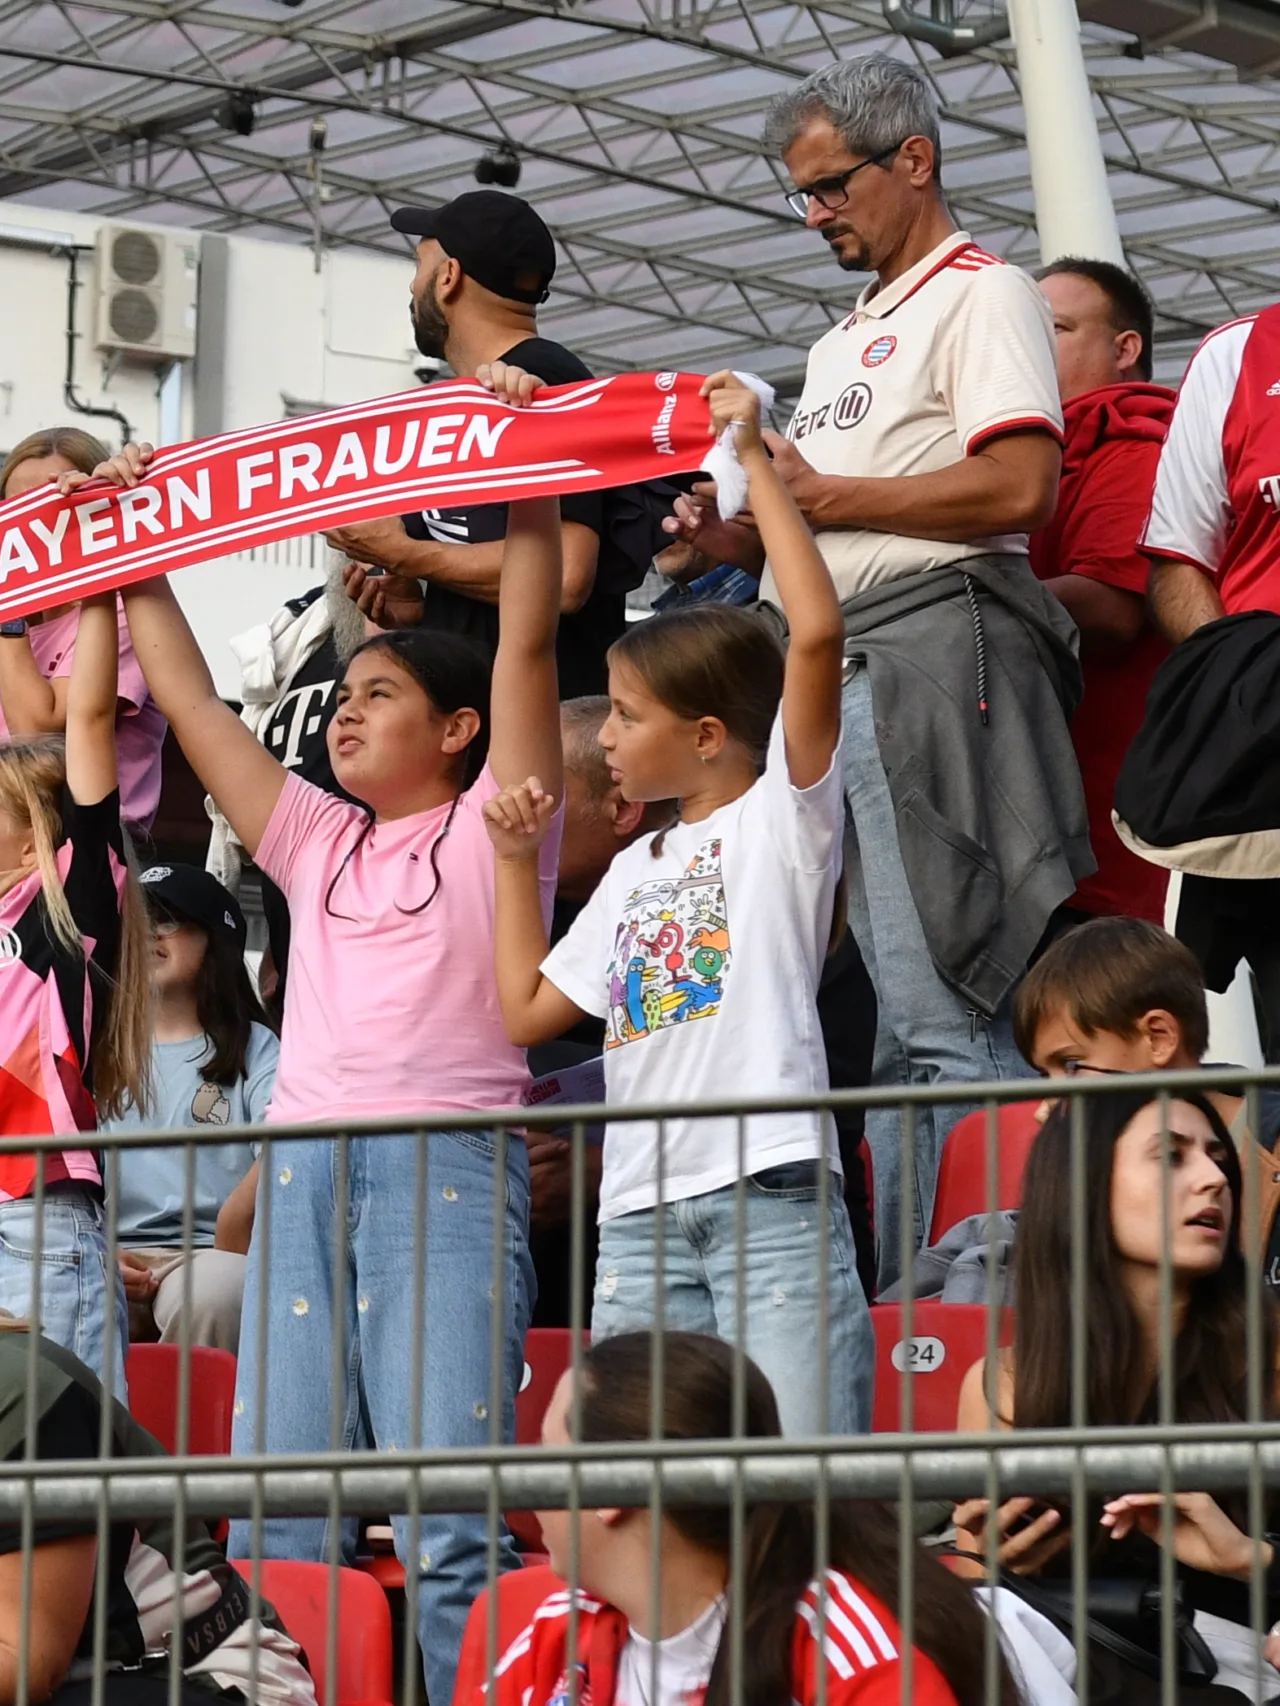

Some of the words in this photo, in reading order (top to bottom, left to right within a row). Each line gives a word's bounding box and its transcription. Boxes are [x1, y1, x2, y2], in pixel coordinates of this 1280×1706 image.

[236, 413, 516, 511] FRAUEN
[651, 393, 677, 455] Allianz
[271, 679, 337, 769] T
[907, 1343, 936, 1365] 24
